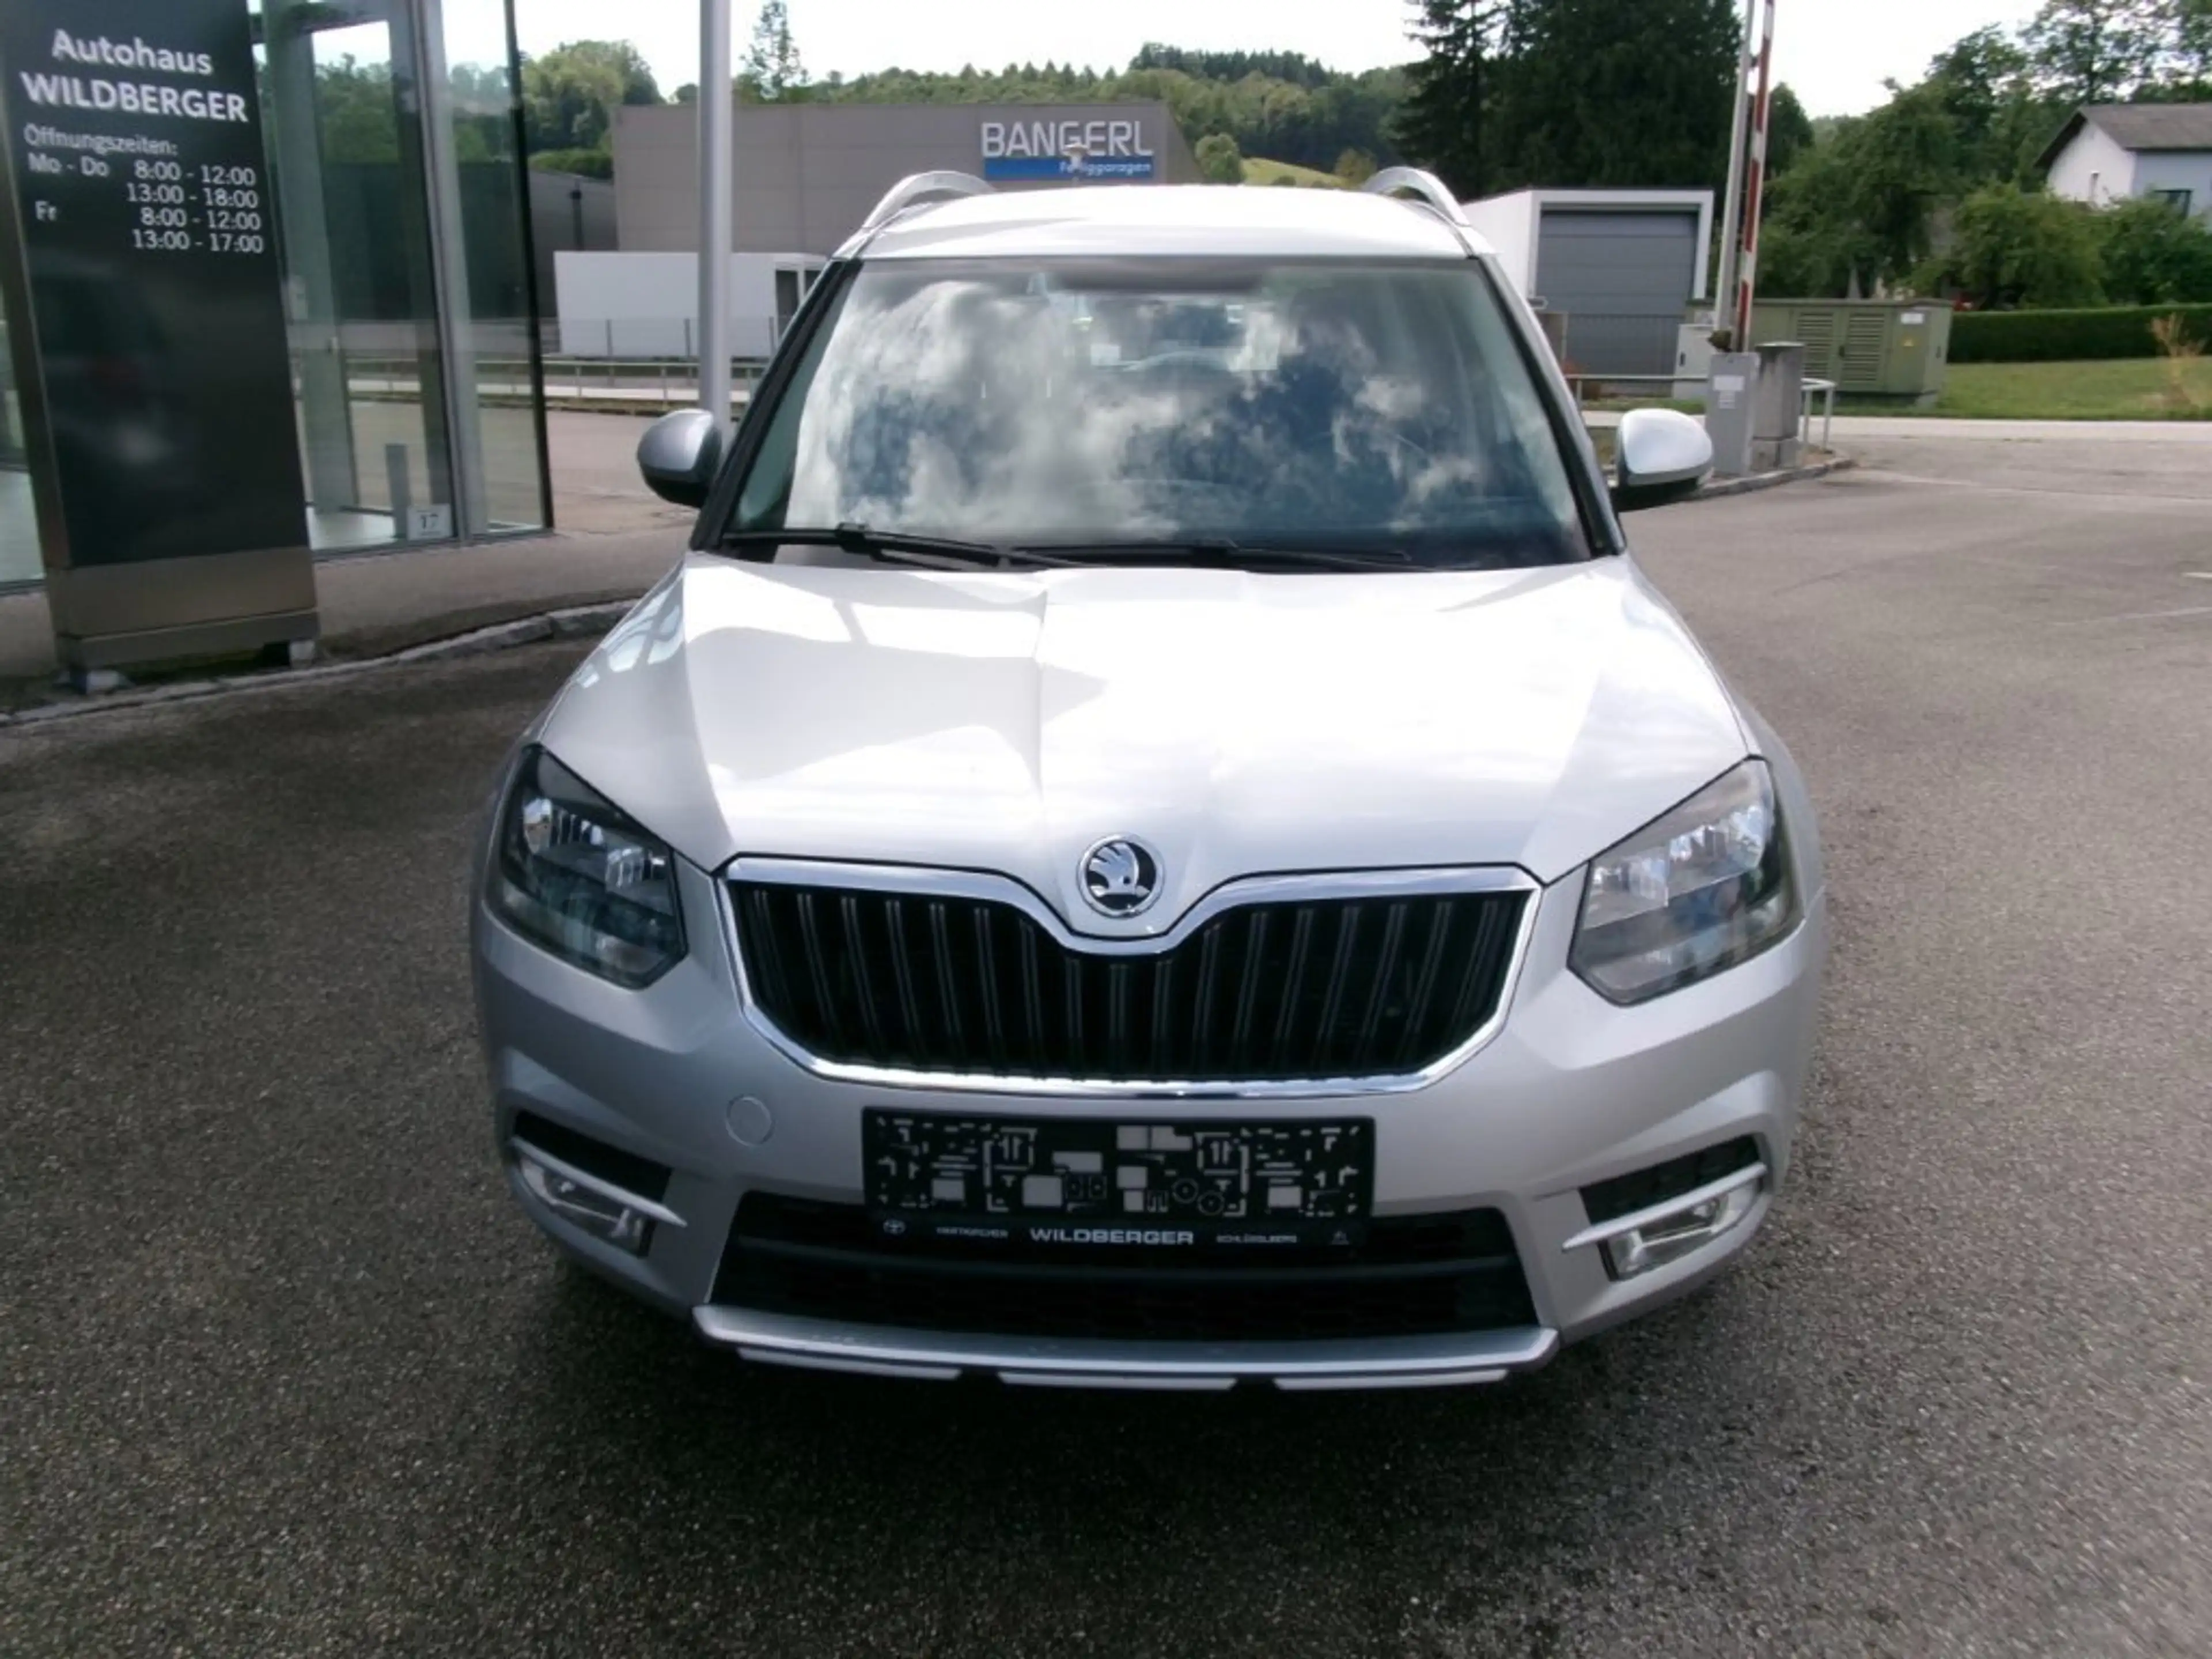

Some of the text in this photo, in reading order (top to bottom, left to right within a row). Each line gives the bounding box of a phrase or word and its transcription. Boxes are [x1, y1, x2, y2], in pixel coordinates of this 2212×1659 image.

[52, 28, 213, 75] Autohaus
[19, 71, 248, 123] WILDBERGER
[981, 120, 1154, 157] BANGERL
[28, 152, 62, 173] Mo
[81, 155, 110, 177] Do
[134, 159, 182, 181] 8:00
[201, 164, 256, 187] 12:00
[126, 182, 185, 204] 13:00
[203, 187, 259, 209] 18:00
[35, 200, 57, 222] Fr
[140, 207, 187, 227] 8:00
[207, 210, 262, 230] 12:00
[132, 229, 191, 250] 13:00
[209, 233, 264, 253] 17:00
[1029, 1228, 1194, 1245] WILDBERGER
